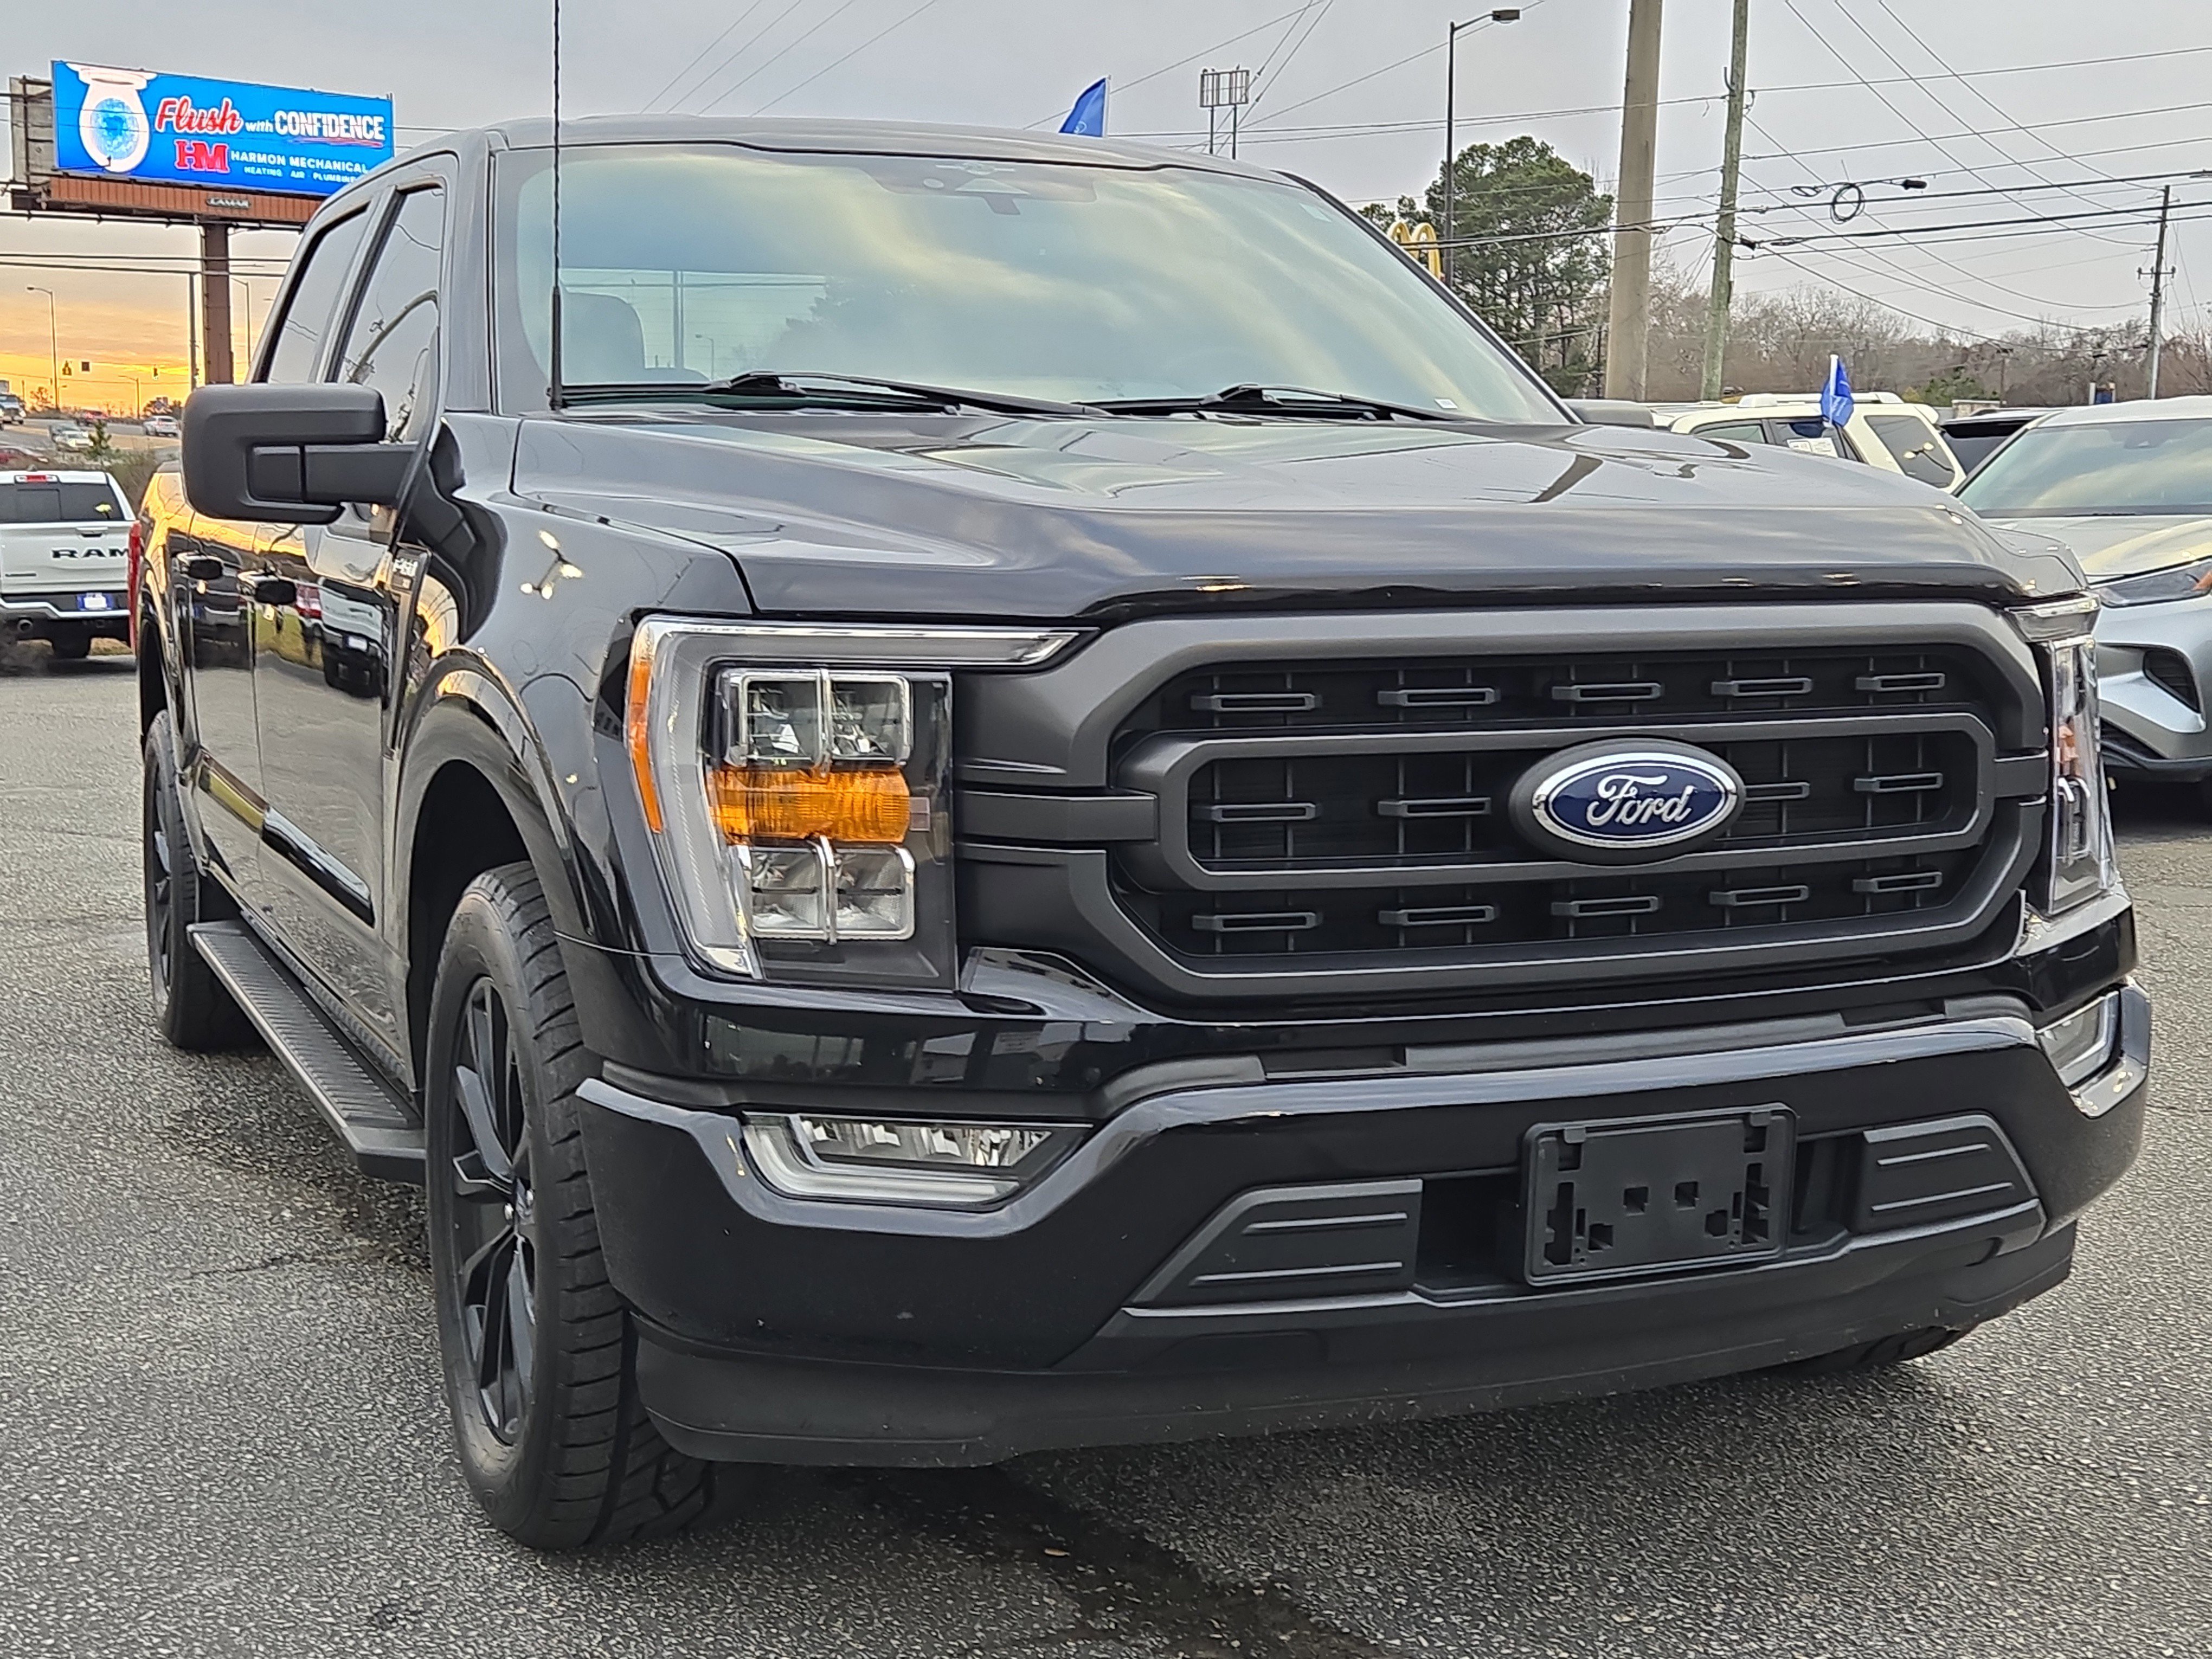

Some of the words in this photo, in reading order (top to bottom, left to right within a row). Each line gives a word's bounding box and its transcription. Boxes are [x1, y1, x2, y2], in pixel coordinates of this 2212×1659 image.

[156, 96, 243, 134] Flush
[245, 119, 274, 133] with
[274, 110, 385, 140] CONFIDENCE
[174, 139, 230, 173] HM
[230, 150, 286, 166] HARMON
[289, 156, 368, 173] MECHANICAL
[244, 166, 282, 177] HEATING
[290, 170, 305, 179] AIR
[52, 548, 129, 559] RAM
[1586, 774, 1694, 826] Ford
